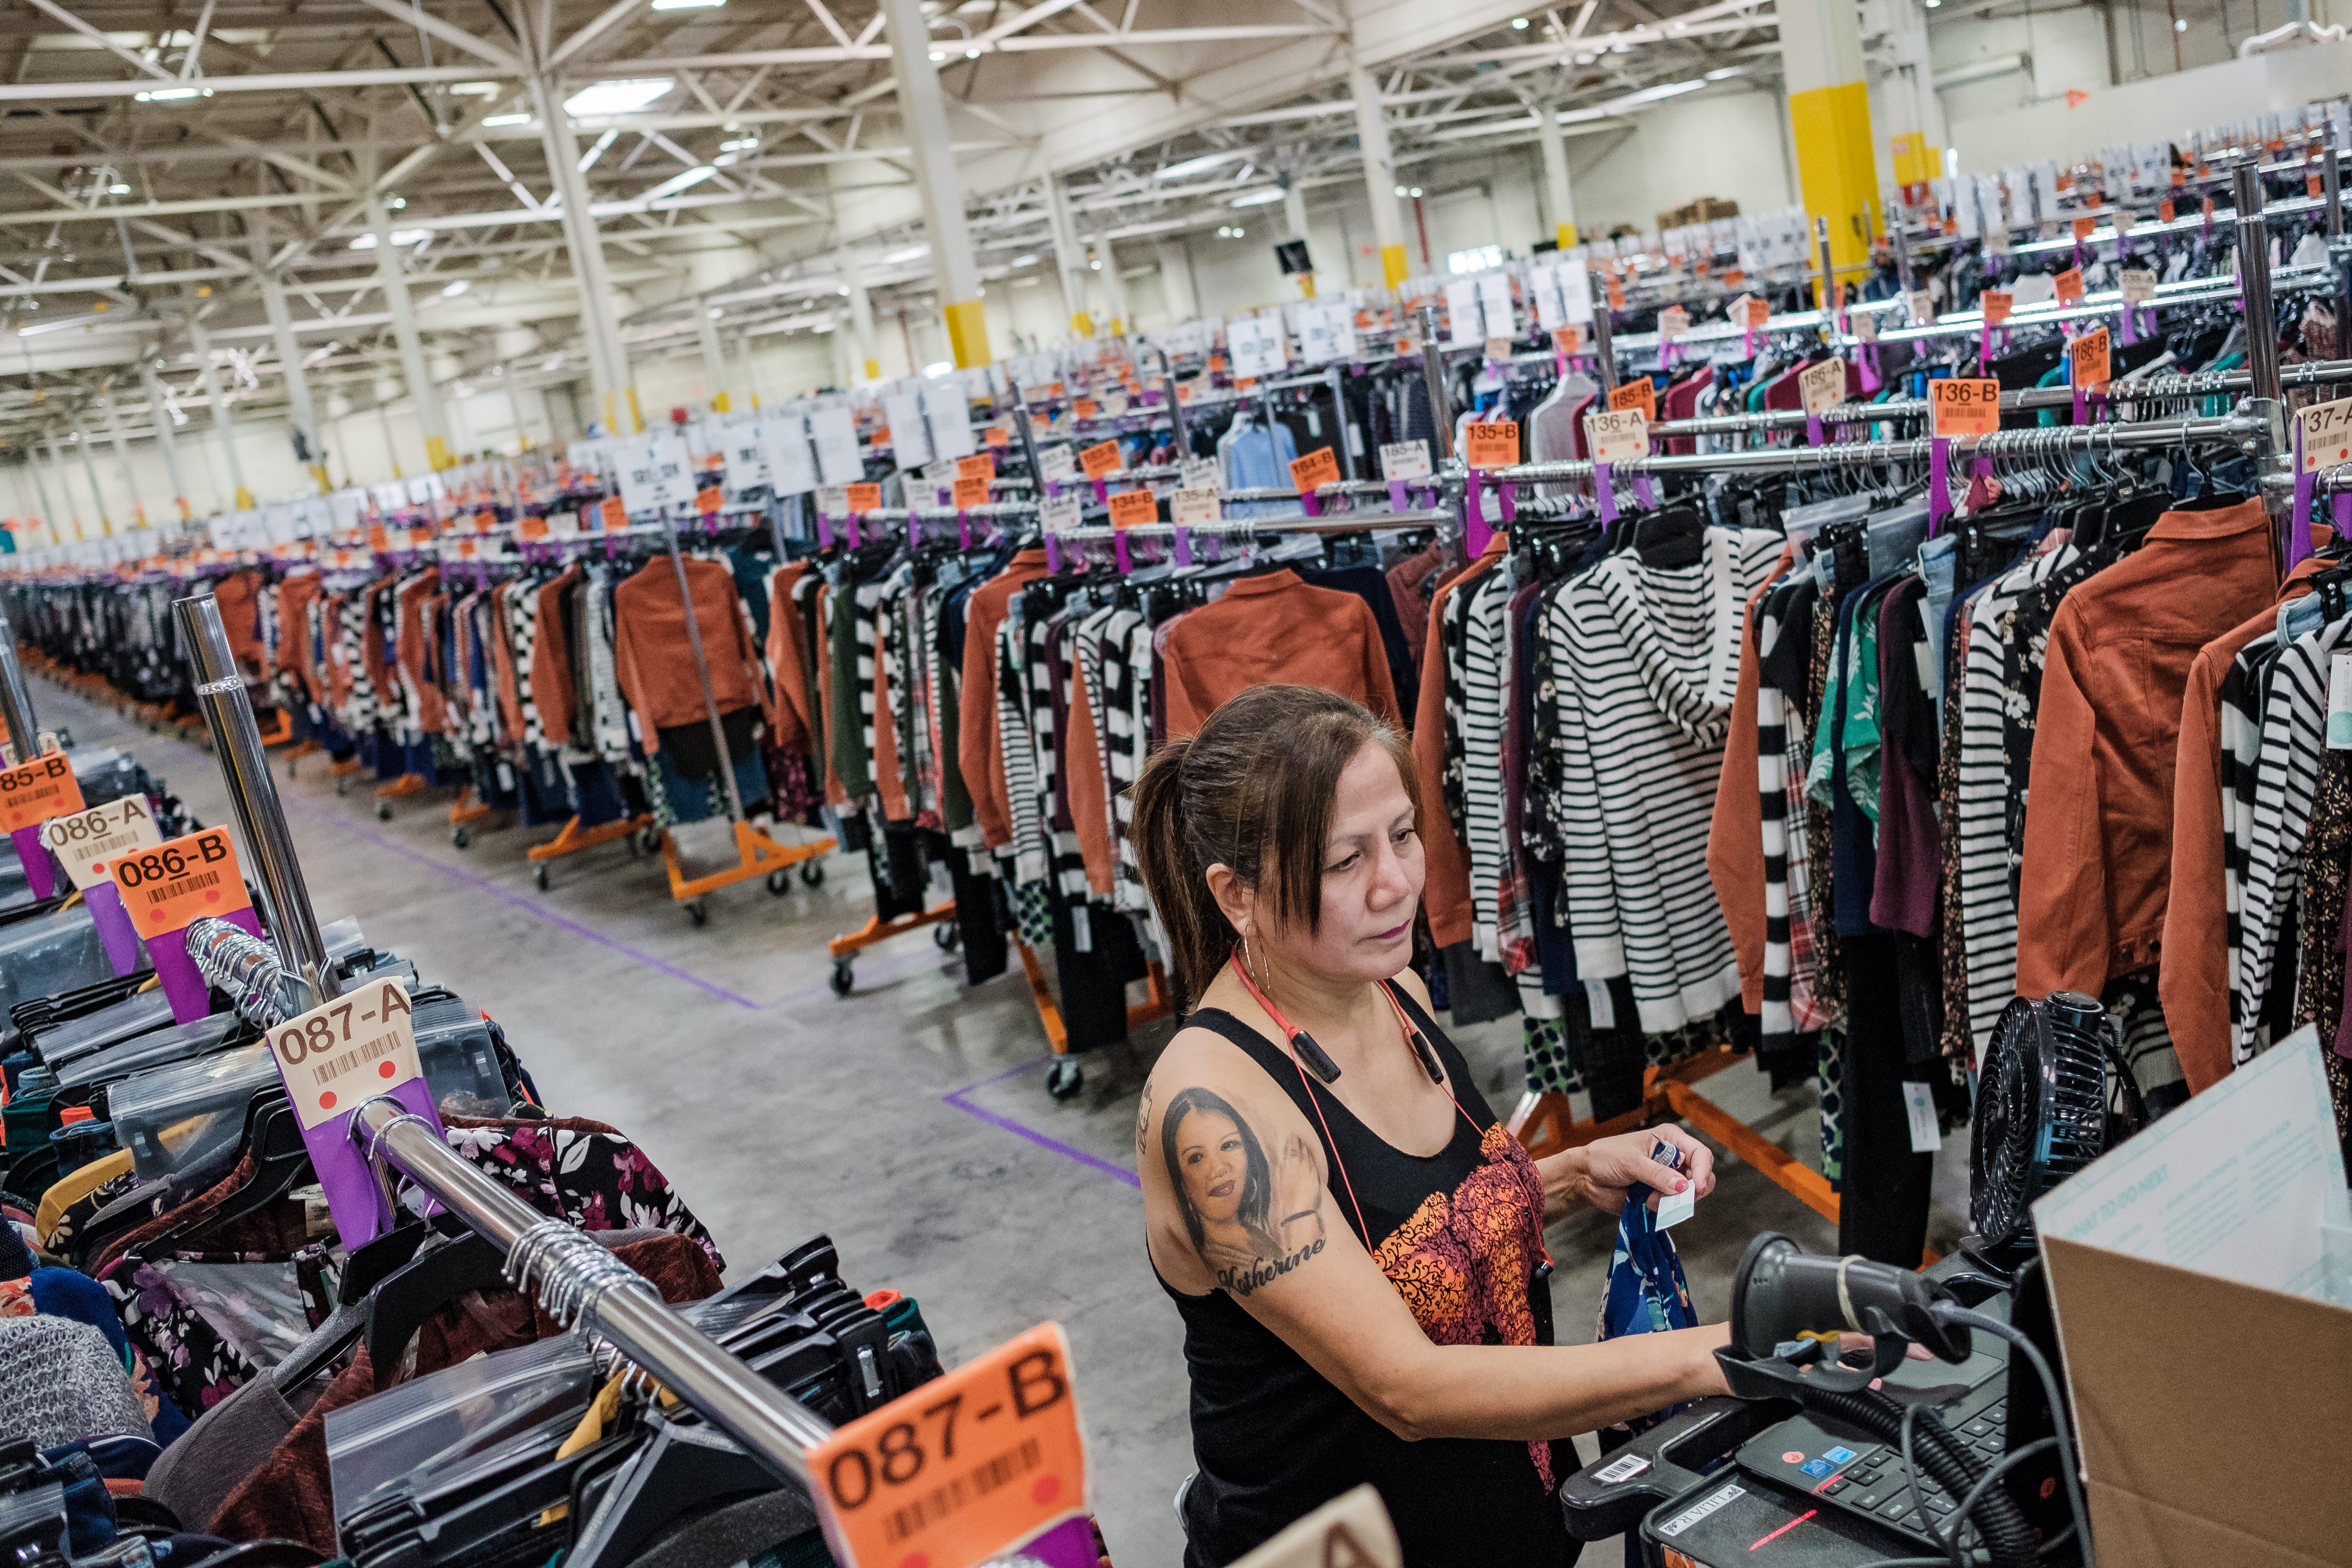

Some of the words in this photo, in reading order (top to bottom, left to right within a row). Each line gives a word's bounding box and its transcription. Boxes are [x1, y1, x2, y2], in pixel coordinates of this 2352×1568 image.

[2076, 335, 2107, 362] 186-B
[1613, 382, 1651, 408] 185-B
[1935, 383, 1997, 405] 136-B
[1468, 422, 1517, 441] 135-B
[1590, 412, 1642, 433] 136-A
[1111, 491, 1154, 509] 134-B
[1174, 488, 1216, 503] 135-A
[49, 799, 147, 847] 086-A
[118, 833, 228, 888] 086-B
[278, 983, 412, 1065] 087-A
[1217, 1238, 1327, 1297] Katherine
[828, 1347, 1067, 1512] 087-B
[1690, 1495, 1725, 1515] LILIA
[1677, 1515, 1692, 1524] R
